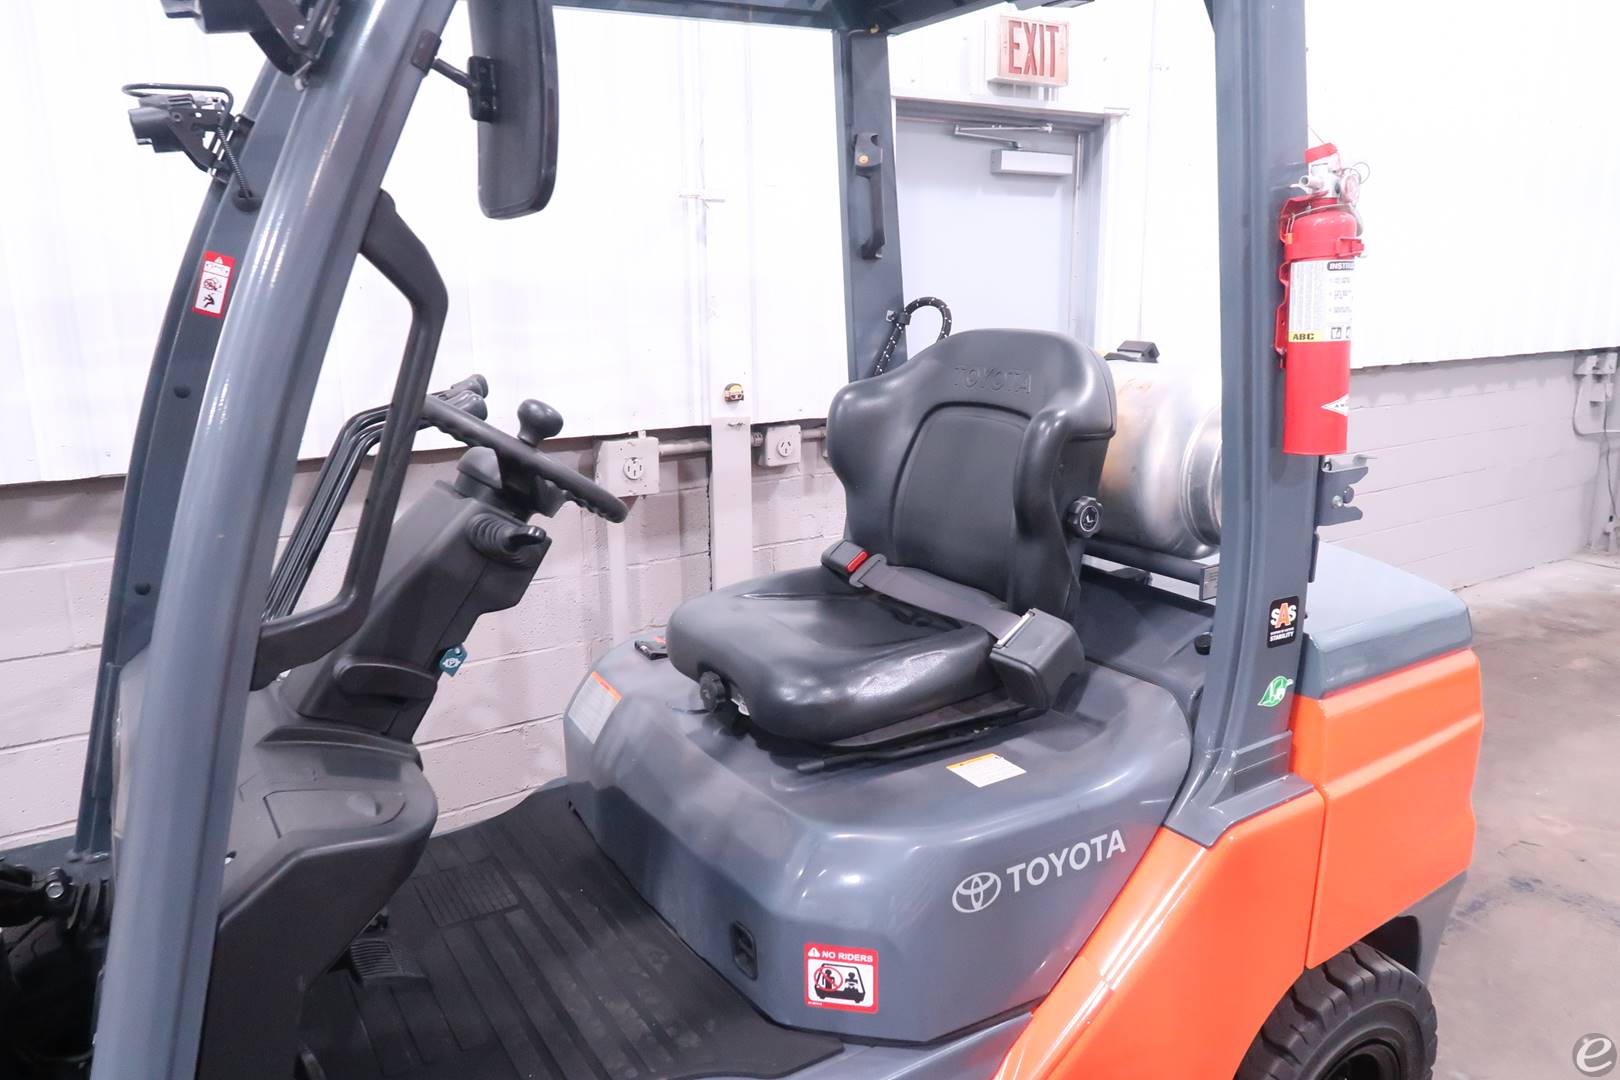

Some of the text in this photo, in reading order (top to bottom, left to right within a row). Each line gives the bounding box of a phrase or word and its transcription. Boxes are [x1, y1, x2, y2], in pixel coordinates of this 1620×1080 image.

[1008, 20, 1059, 77] EXIT
[954, 367, 1032, 394] TOYOTA
[1270, 602, 1297, 628] SAS
[1269, 631, 1295, 641] STABILITY
[1006, 829, 1126, 892] TOYOTA
[822, 950, 873, 963] NO RIDERS
